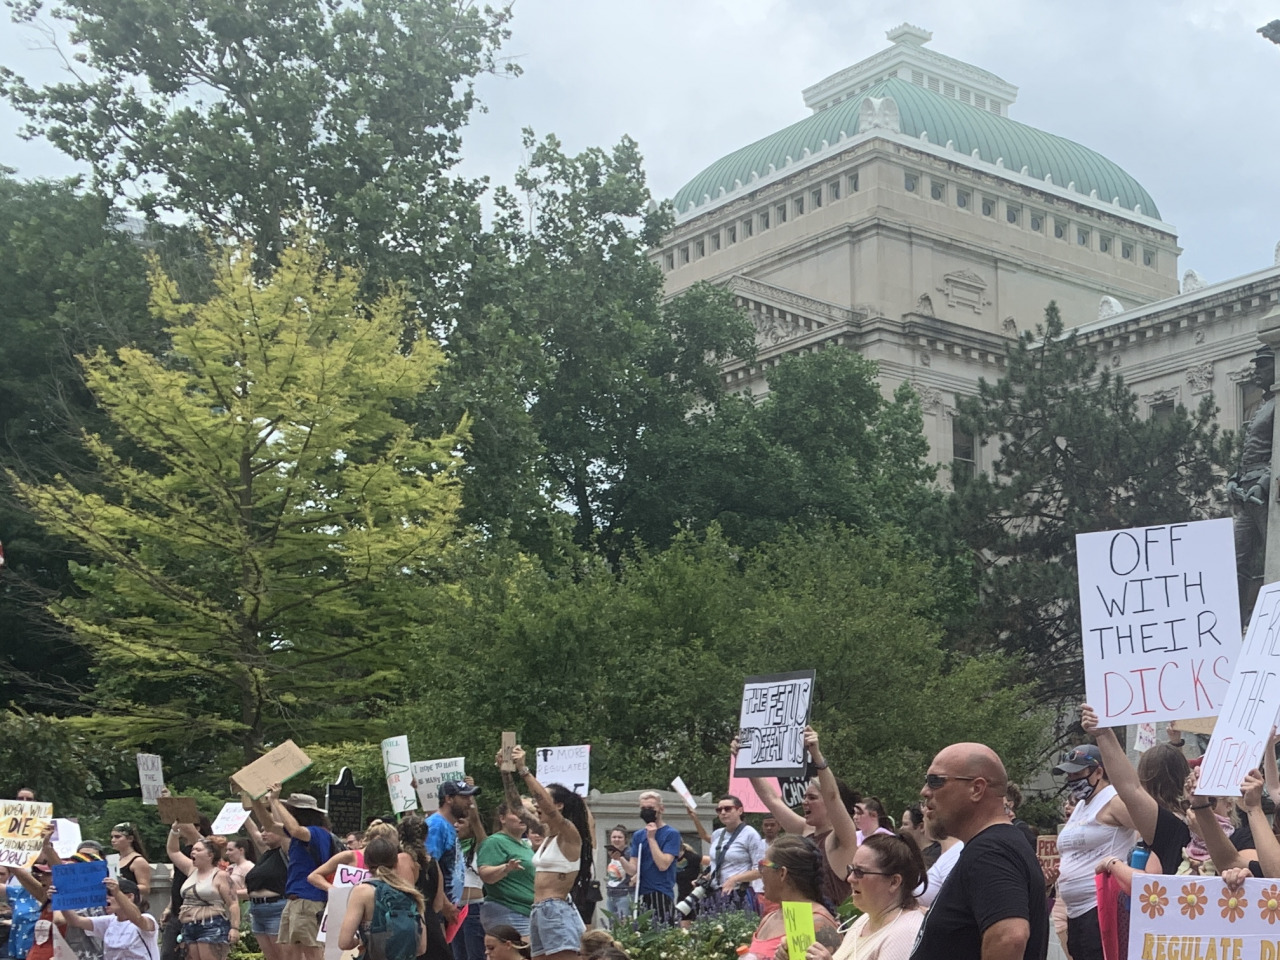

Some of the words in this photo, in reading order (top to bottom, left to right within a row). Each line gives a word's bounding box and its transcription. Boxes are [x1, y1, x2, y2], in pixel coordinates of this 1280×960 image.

[1109, 524, 1188, 575] OFF
[1096, 571, 1206, 618] WITH
[1090, 610, 1222, 660] THEIR
[745, 687, 767, 714] THE
[764, 682, 810, 726] FETUS
[1228, 670, 1277, 736] THE
[538, 762, 588, 775] REGULATED
[557, 747, 585, 760] MORE
[8, 817, 33, 836] DIE
